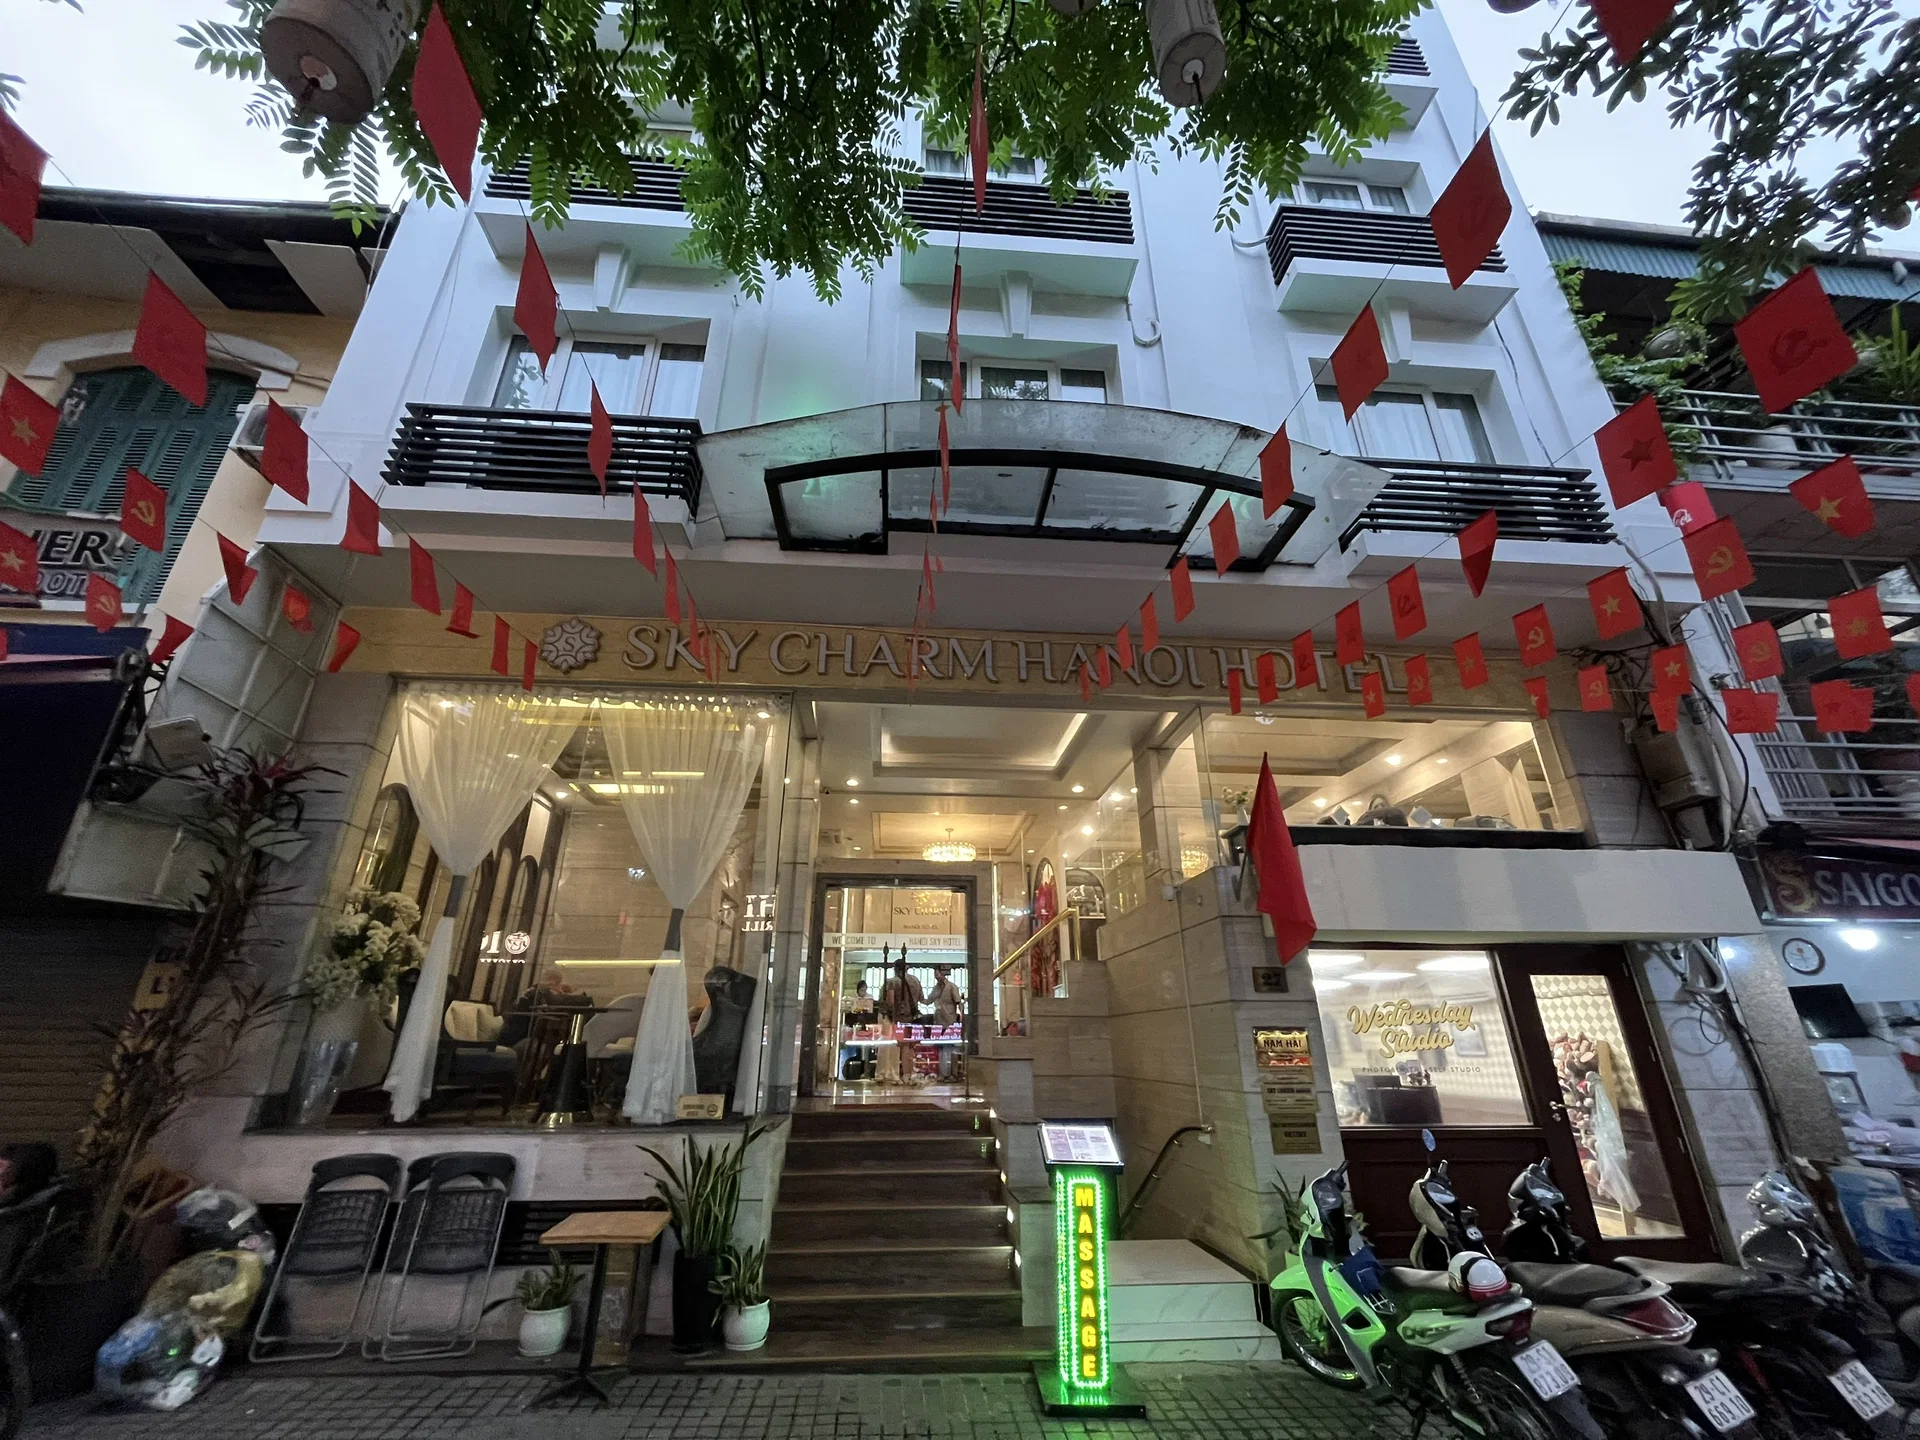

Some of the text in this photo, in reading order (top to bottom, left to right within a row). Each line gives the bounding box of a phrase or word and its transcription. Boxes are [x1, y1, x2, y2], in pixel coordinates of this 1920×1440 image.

[32, 530, 109, 566] ER
[621, 625, 1408, 693] SKY CHARM HANOI HOTEL
[894, 907, 911, 916] SKY
[1347, 999, 1475, 1034] Wednesday
[1264, 1039, 1283, 1048] NAM
[1380, 1027, 1454, 1058] Studio
[1075, 1188, 1097, 1378] MASSAGE
[1694, 1375, 1732, 1404] 29-C1
